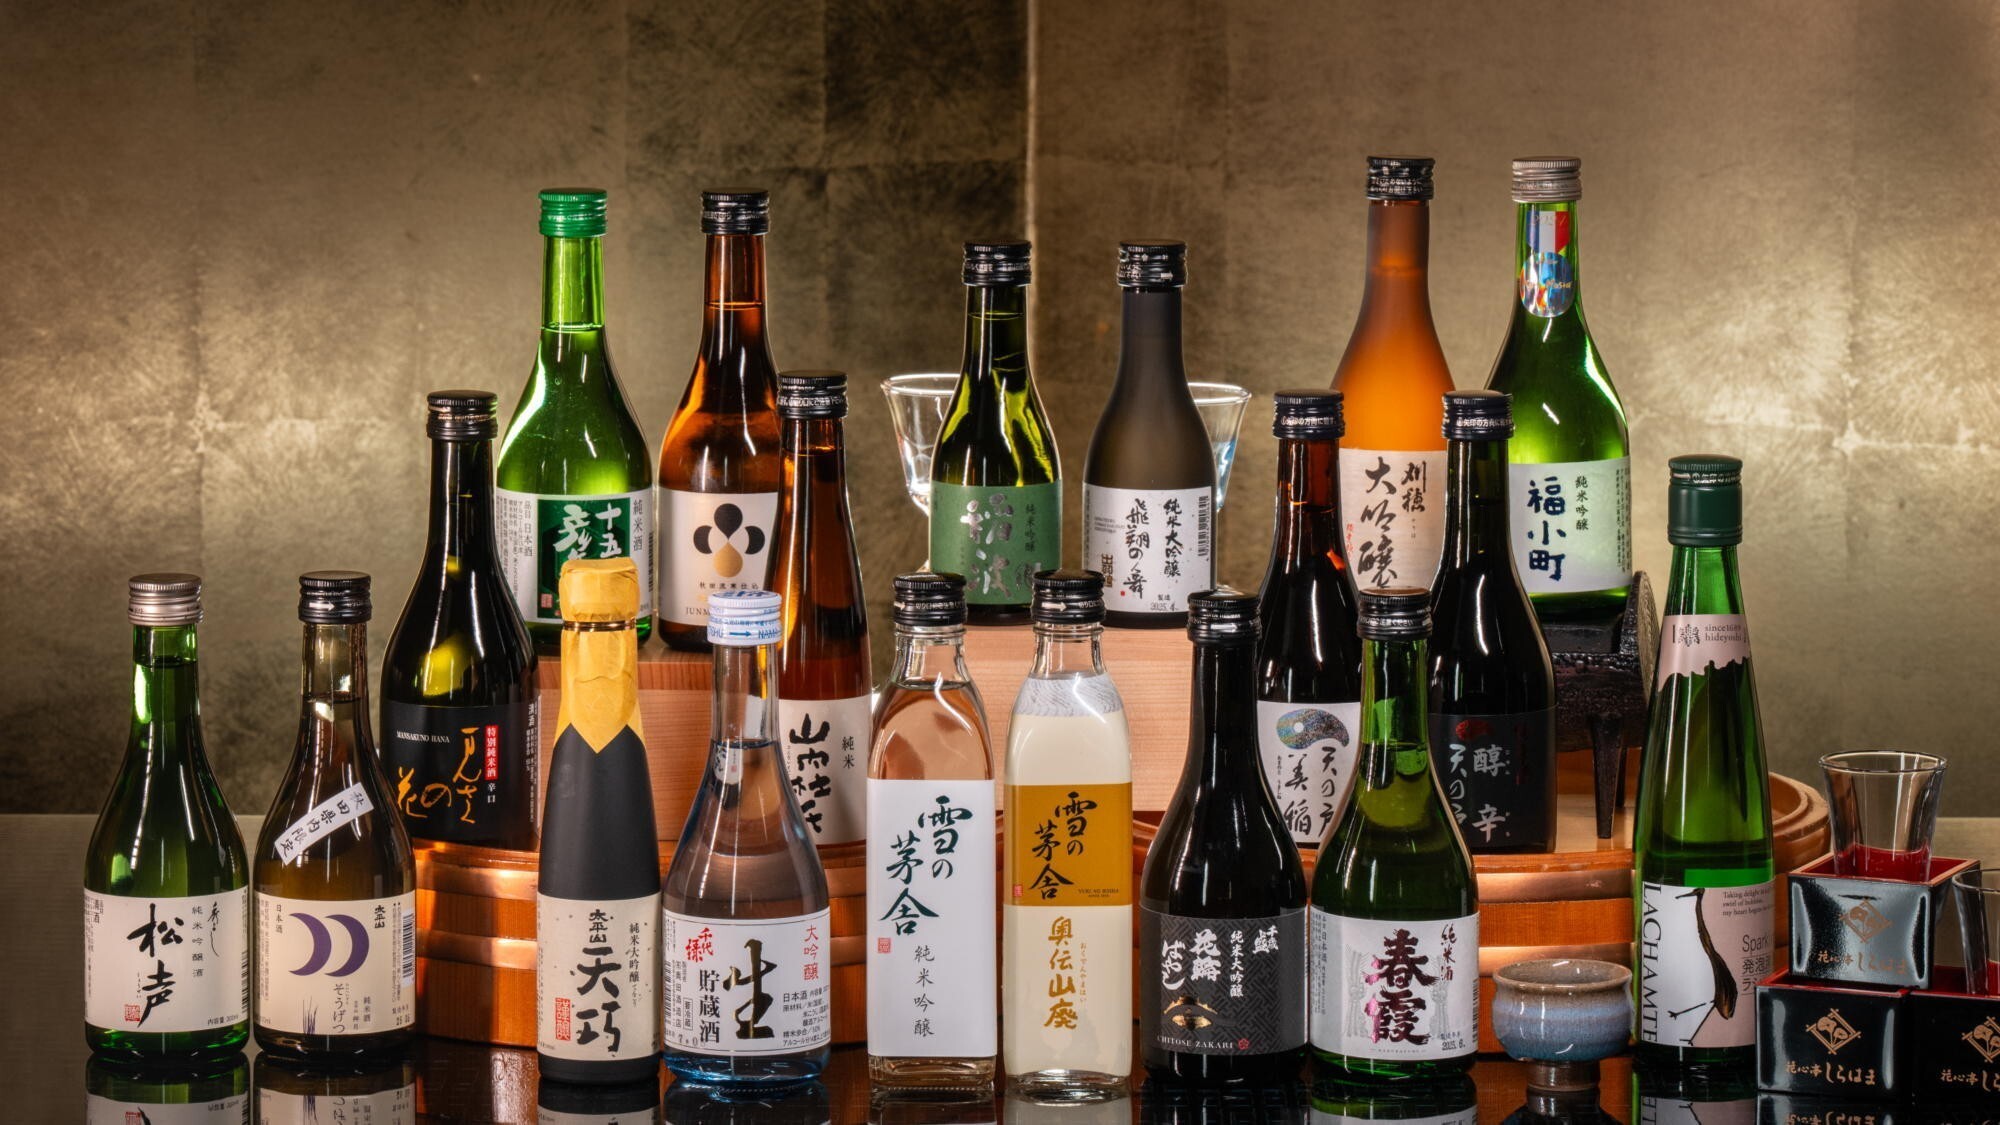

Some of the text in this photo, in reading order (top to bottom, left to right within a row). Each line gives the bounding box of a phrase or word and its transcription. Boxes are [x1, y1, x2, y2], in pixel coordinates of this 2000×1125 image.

[1401, 461, 1427, 512] 刈穂
[1575, 476, 1588, 531] 純米吟醸
[633, 500, 643, 551] 純米酒
[1123, 498, 1150, 599] 飛翔の舞
[1163, 498, 1182, 578] 純米大吟醸
[1358, 456, 1397, 588] 大吟醸
[1527, 476, 1566, 581] 福小町
[396, 730, 429, 742] MANSAKUNO
[486, 727, 497, 777] 特別純米酒
[842, 736, 854, 769] 純米
[487, 783, 496, 803] 辛口
[1472, 744, 1506, 843] 醇辛
[280, 791, 364, 858] 秋田県内限定
[374, 904, 386, 928] 太平山
[1723, 891, 1742, 899] Taking
[192, 906, 204, 977] 純米吟醸酒
[589, 909, 608, 943] 太平山
[626, 923, 640, 983] 純米大吟醸
[804, 925, 819, 980] 大吟醸
[1440, 923, 1457, 981] 純米酒
[127, 903, 184, 1028] 松声
[723, 939, 777, 1039] 生
[913, 945, 935, 1037] 純米吟醸
[1044, 916, 1078, 1029] 奥伝山廃
[1229, 930, 1244, 998] 純米大吟醸
[1363, 928, 1439, 1046] 春霞
[1643, 882, 1661, 1042] LACHAMTE
[208, 1017, 224, 1025] 内容量
[333, 983, 346, 1033] そうげつ
[575, 947, 622, 1052] 天巧
[699, 969, 720, 1043] 貯蔵酒
[783, 990, 808, 1003] 日本酒
[1157, 1035, 1234, 1049] CHITOSE ZAKARI
[1786, 1061, 1876, 1085] 花心亭しらはま
